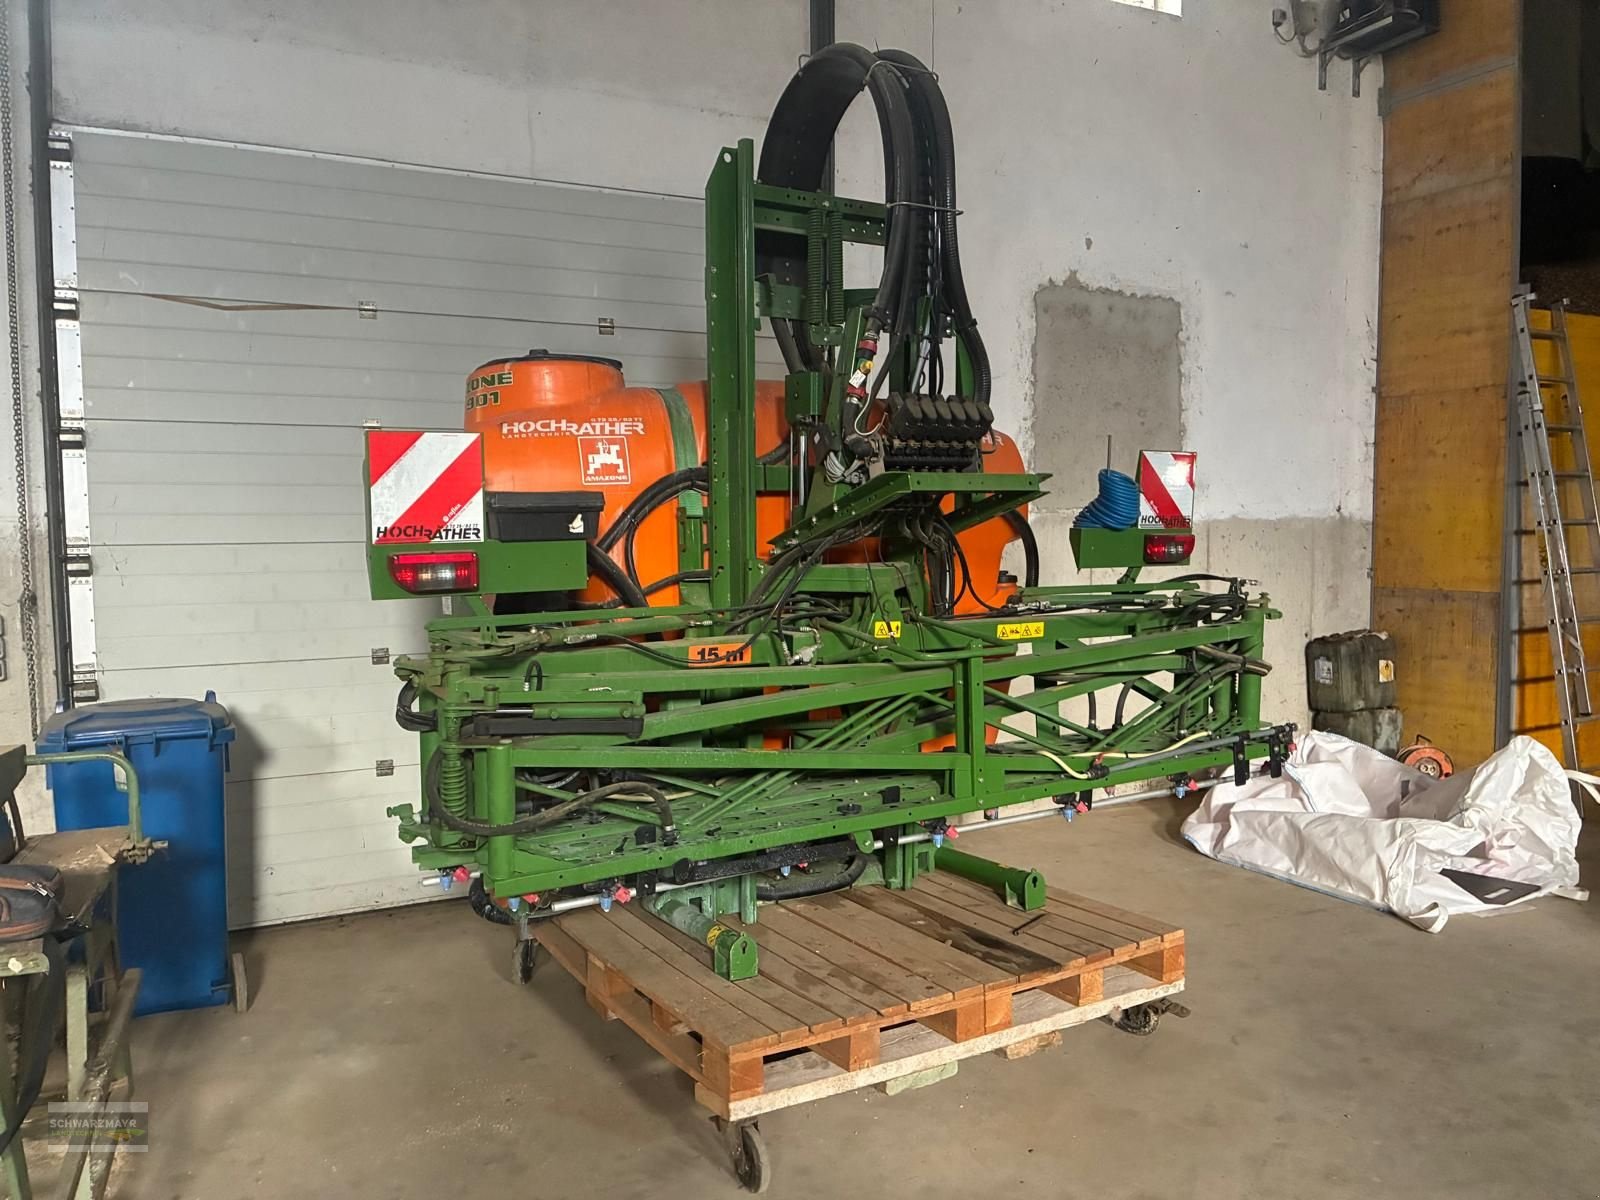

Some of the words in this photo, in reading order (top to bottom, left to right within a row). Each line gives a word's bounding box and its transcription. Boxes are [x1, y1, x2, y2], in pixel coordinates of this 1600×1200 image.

[502, 419, 645, 436] HOCHRATHER
[376, 525, 481, 540] HOCHRATHER
[697, 647, 719, 662] 15
